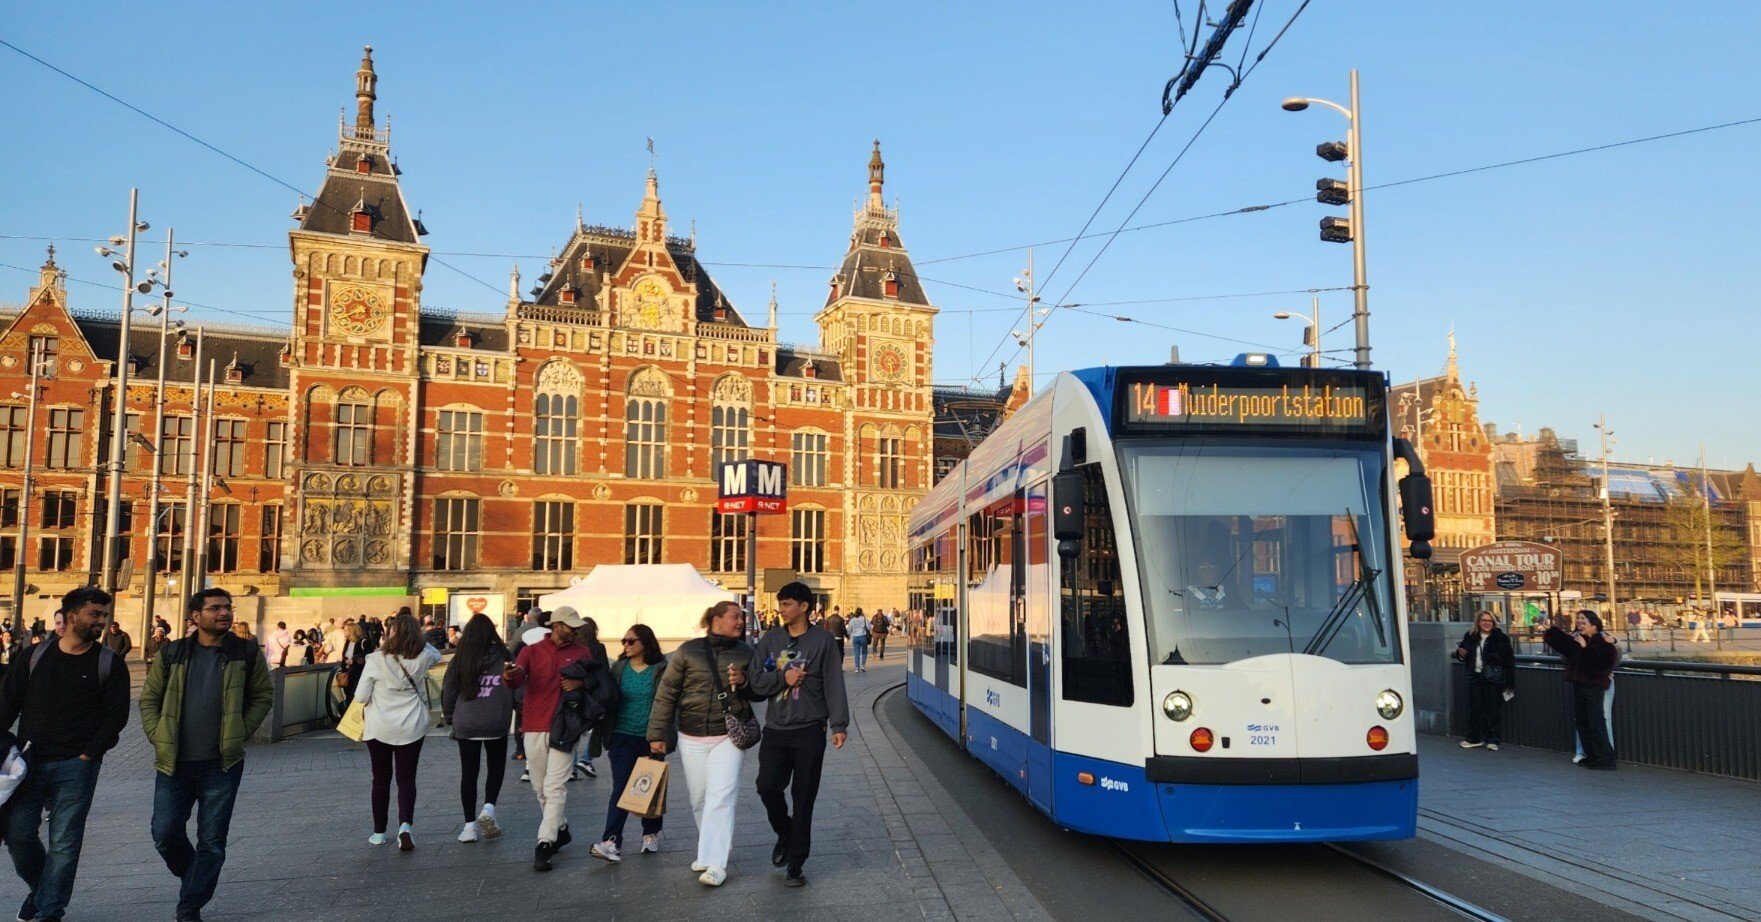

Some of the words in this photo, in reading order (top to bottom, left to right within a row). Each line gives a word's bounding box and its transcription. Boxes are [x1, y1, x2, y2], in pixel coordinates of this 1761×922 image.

[1134, 382, 1155, 415] 14
[1178, 382, 1363, 424] Muiderpoortstation
[724, 463, 747, 496] M
[758, 463, 781, 496] M
[1466, 554, 1512, 567] CANAL
[1515, 553, 1555, 566] TOUR
[1250, 735, 1276, 745] 2021
[1113, 780, 1129, 792] GVB
